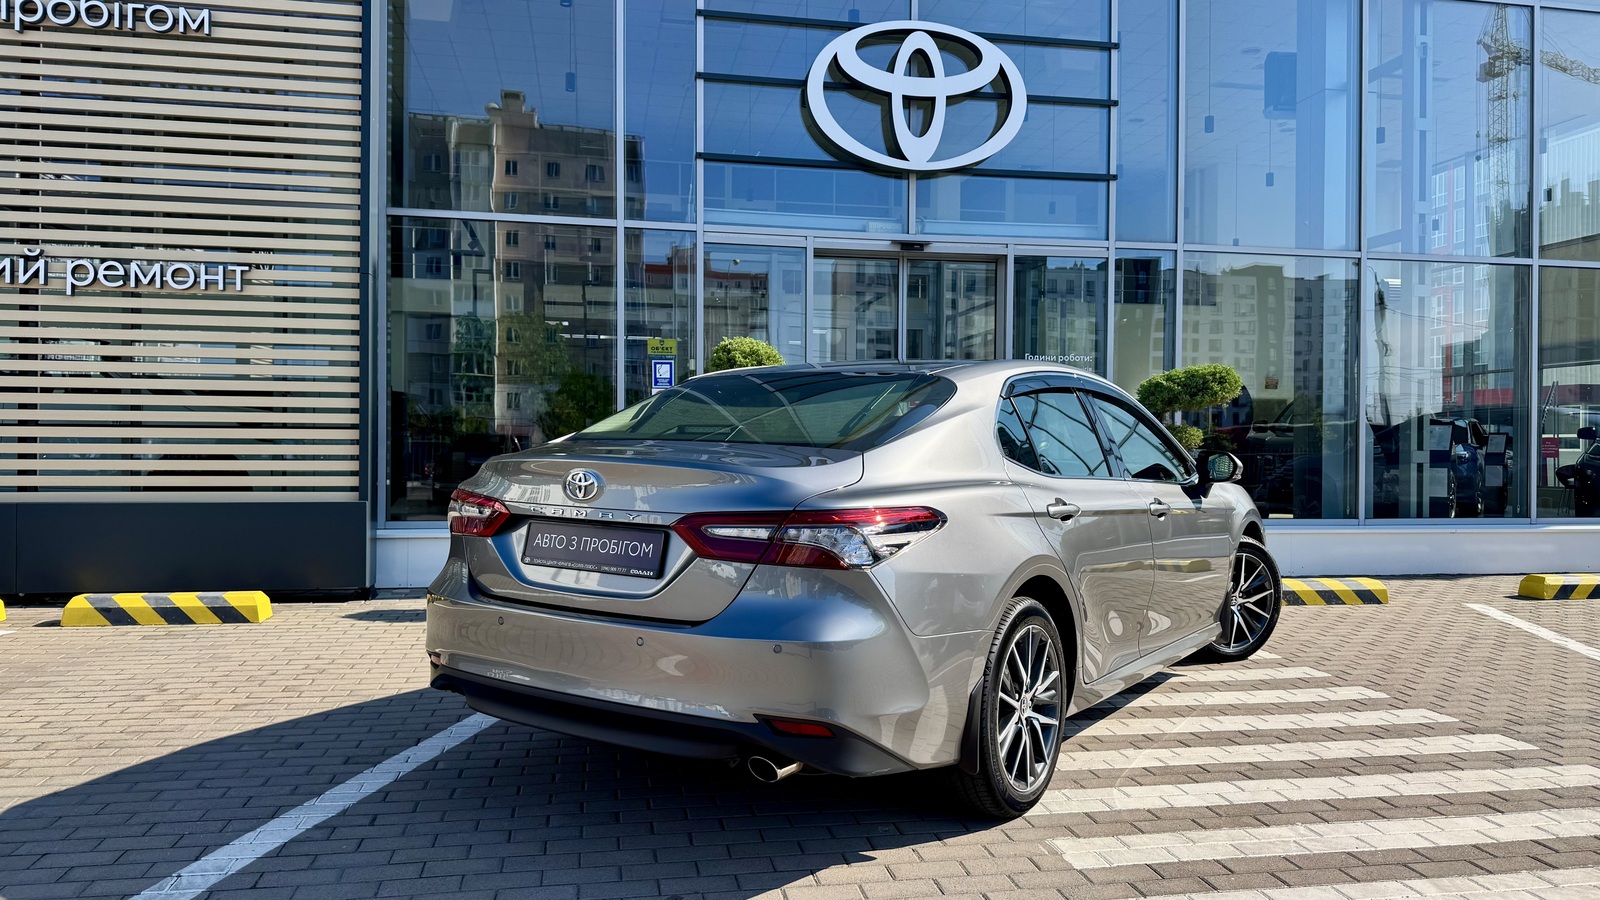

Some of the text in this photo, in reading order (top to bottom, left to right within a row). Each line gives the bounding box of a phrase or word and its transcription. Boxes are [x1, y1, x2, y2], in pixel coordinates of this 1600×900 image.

[66, 258, 249, 295] ремонт
[1025, 353, 1093, 363] Години роботи:
[530, 506, 642, 520] CAMRY
[533, 533, 567, 550] АВТО
[580, 537, 654, 558] ПРОБІГОМ
